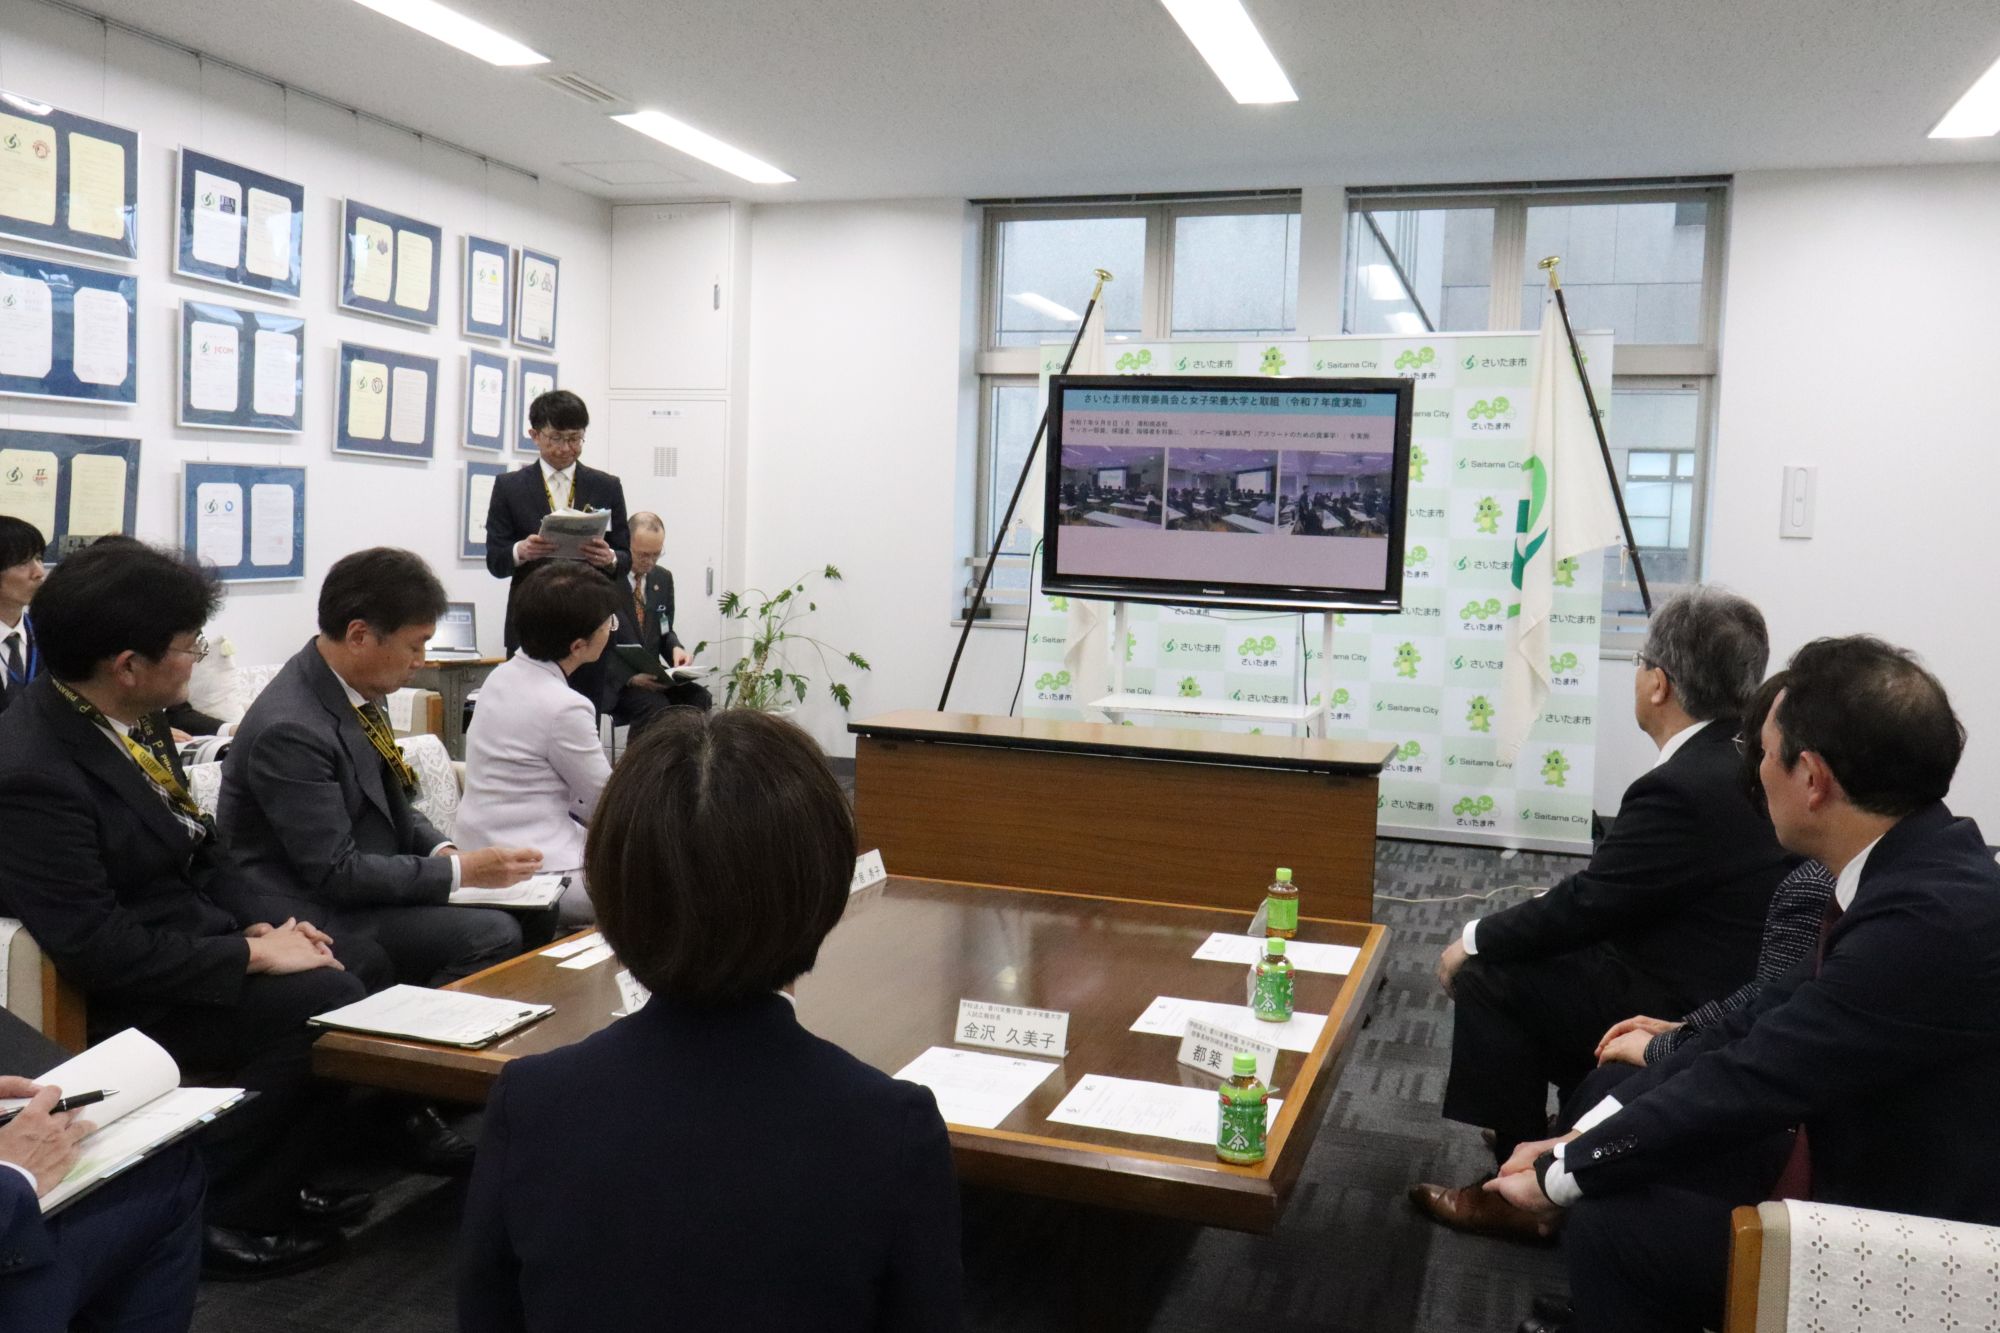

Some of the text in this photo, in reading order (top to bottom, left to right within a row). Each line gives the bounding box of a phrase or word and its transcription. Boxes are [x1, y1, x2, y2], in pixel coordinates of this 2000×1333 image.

[1192, 360, 1233, 369] さいたま市
[1327, 361, 1378, 369] Saitama City
[1481, 358, 1527, 367] さいたま市
[1471, 460, 1505, 468] Saitama
[1408, 509, 1445, 518] いたま市
[1549, 614, 1596, 624] さいたま市
[1463, 622, 1503, 631] さいたま市
[1180, 643, 1221, 653] さいたま市
[1241, 658, 1278, 667] さいたま市
[1351, 653, 1367, 662] City
[1470, 659, 1504, 669] さいたま
[1247, 694, 1289, 704] さいたま市
[1387, 704, 1440, 715] Saitama City
[1544, 713, 1592, 725] さいたま市
[1459, 758, 1494, 767] Saitama
[1390, 800, 1434, 811] さいたま市
[1456, 818, 1496, 827] さいたま市
[1534, 812, 1589, 825] Saitama City
[963, 1021, 1056, 1049] 金沢 久美子
[1192, 1044, 1223, 1070] 都築
[1226, 1125, 1250, 1151] 茶
